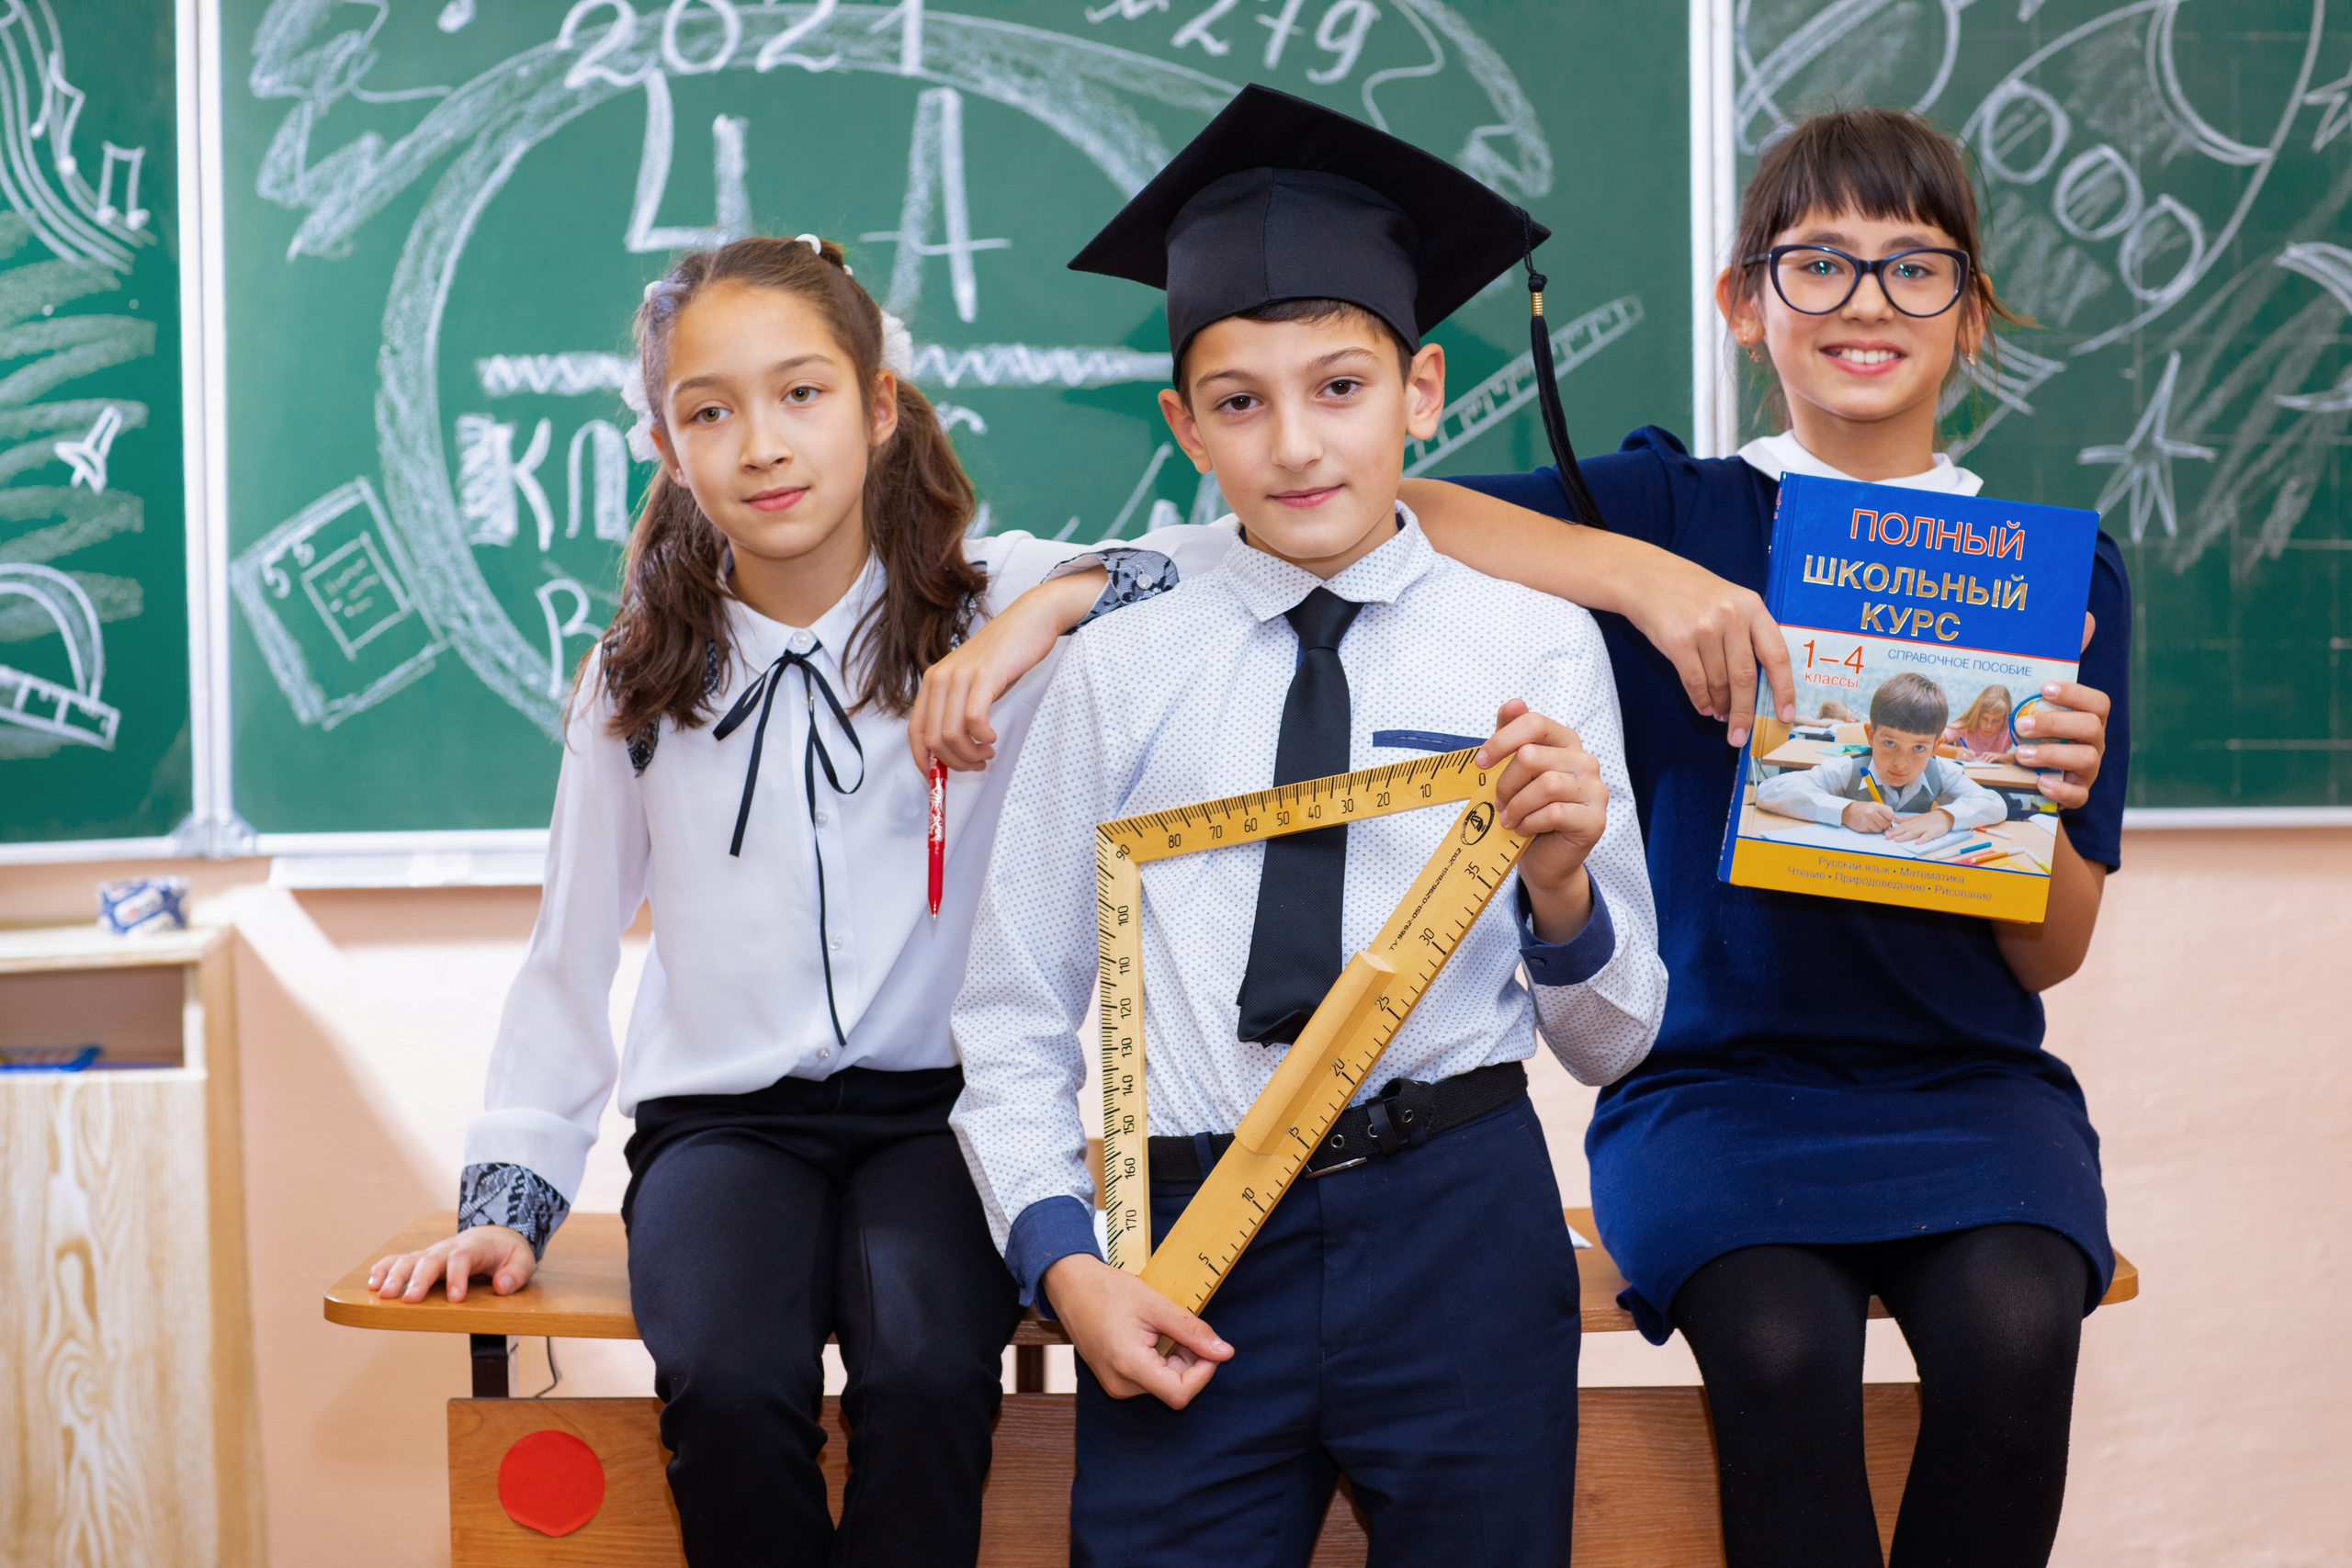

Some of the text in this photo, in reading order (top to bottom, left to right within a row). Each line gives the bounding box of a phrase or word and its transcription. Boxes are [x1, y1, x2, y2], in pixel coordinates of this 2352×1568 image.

[555, 0, 922, 89] 2021
[1849, 508, 2025, 560] ПОЛНЫЙ
[1803, 554, 2028, 611] ШКОЛЬНЫЙ
[1860, 602, 1961, 641] КУРС
[1804, 671, 1860, 688] классы
[1888, 649, 2033, 677] СПРАВОЧНОЕ ПОСОБИЕ
[1115, 773, 1487, 861] 90 80 70 60 50 40 30 20 10 0
[1787, 866, 1992, 901] Чтение Природоведение Рисование
[1818, 856, 1965, 884] Русский язык Математика
[1389, 939, 1398, 951] ТУ
[1117, 905, 1137, 1232] 170 160 150 140 130 120 110 100
[1198, 1252, 1210, 1265] 5
[1241, 1187, 1255, 1202] 10
[1374, 995, 1390, 1011] 25
[1419, 927, 1435, 946] 30
[1464, 861, 1480, 880] 35
